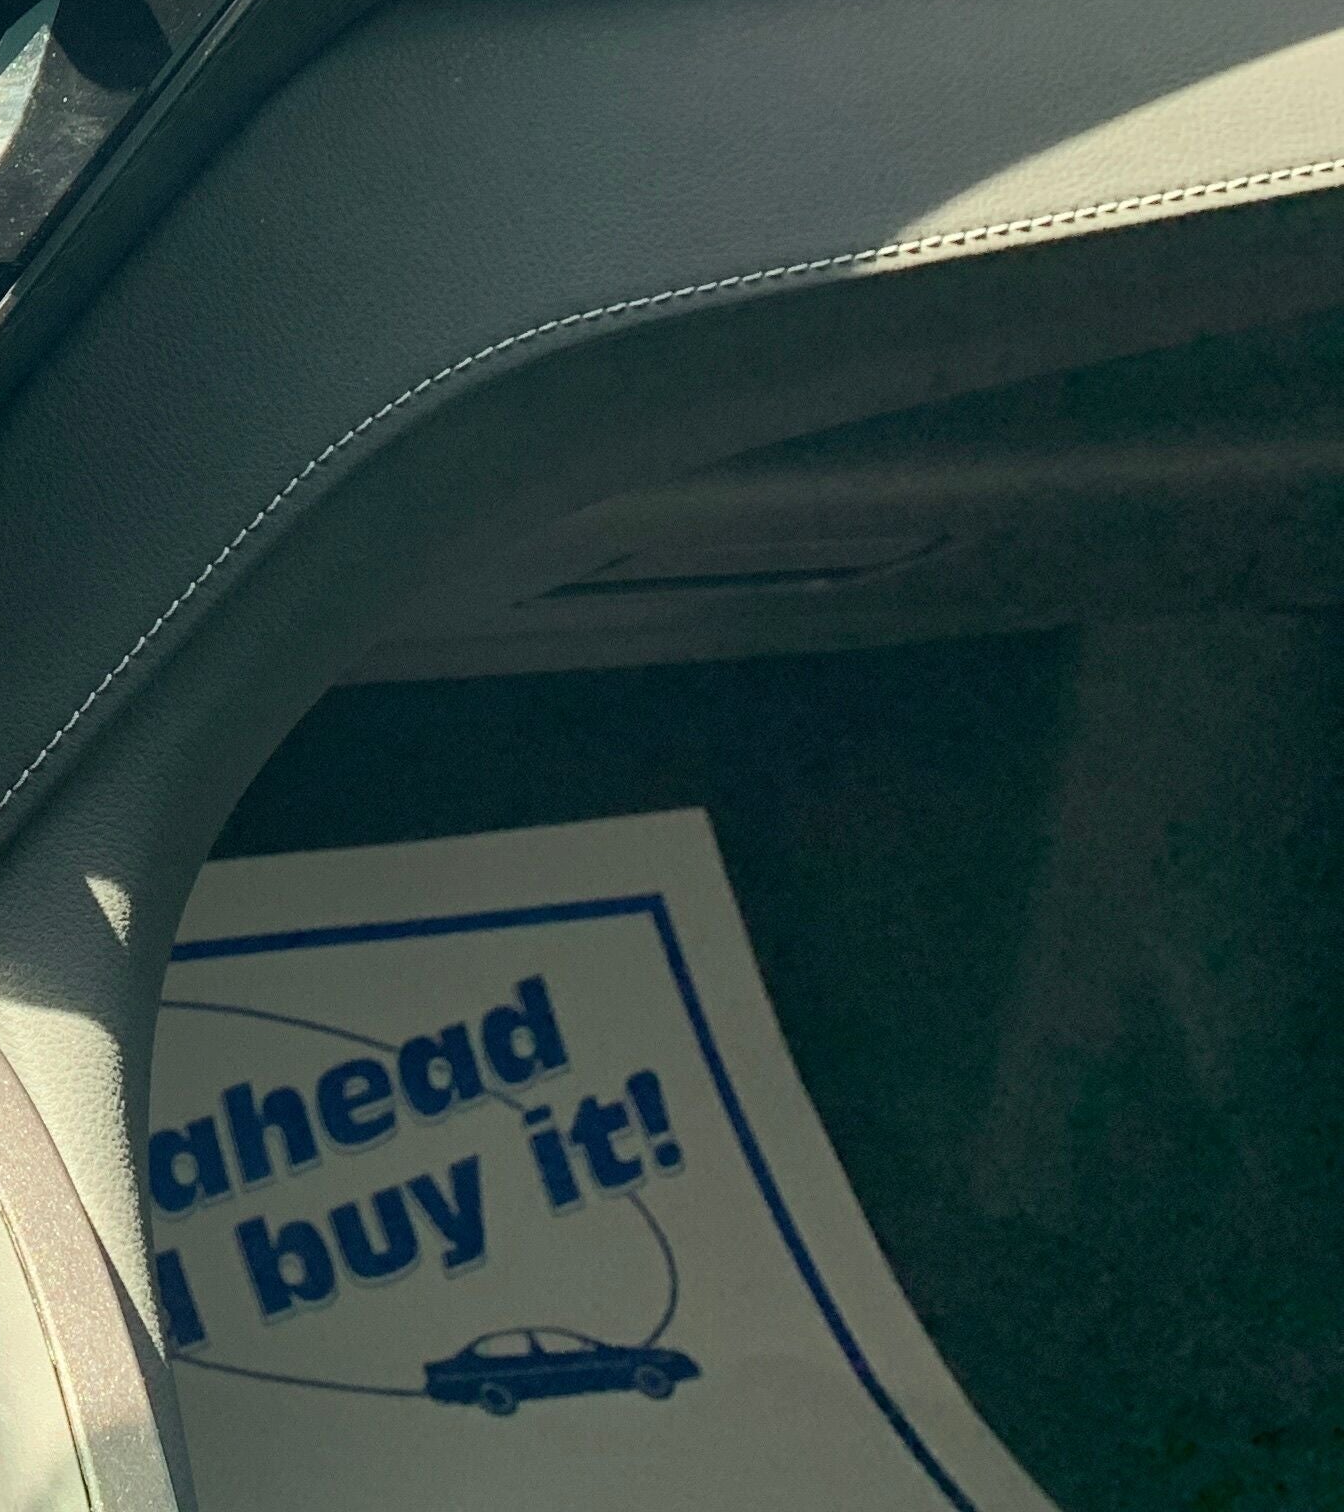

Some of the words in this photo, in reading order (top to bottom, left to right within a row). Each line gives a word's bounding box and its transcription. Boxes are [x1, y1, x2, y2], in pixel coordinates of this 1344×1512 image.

[148, 974, 568, 1215] ahead
[236, 1155, 485, 1316] buy
[523, 1069, 683, 1210] it!
